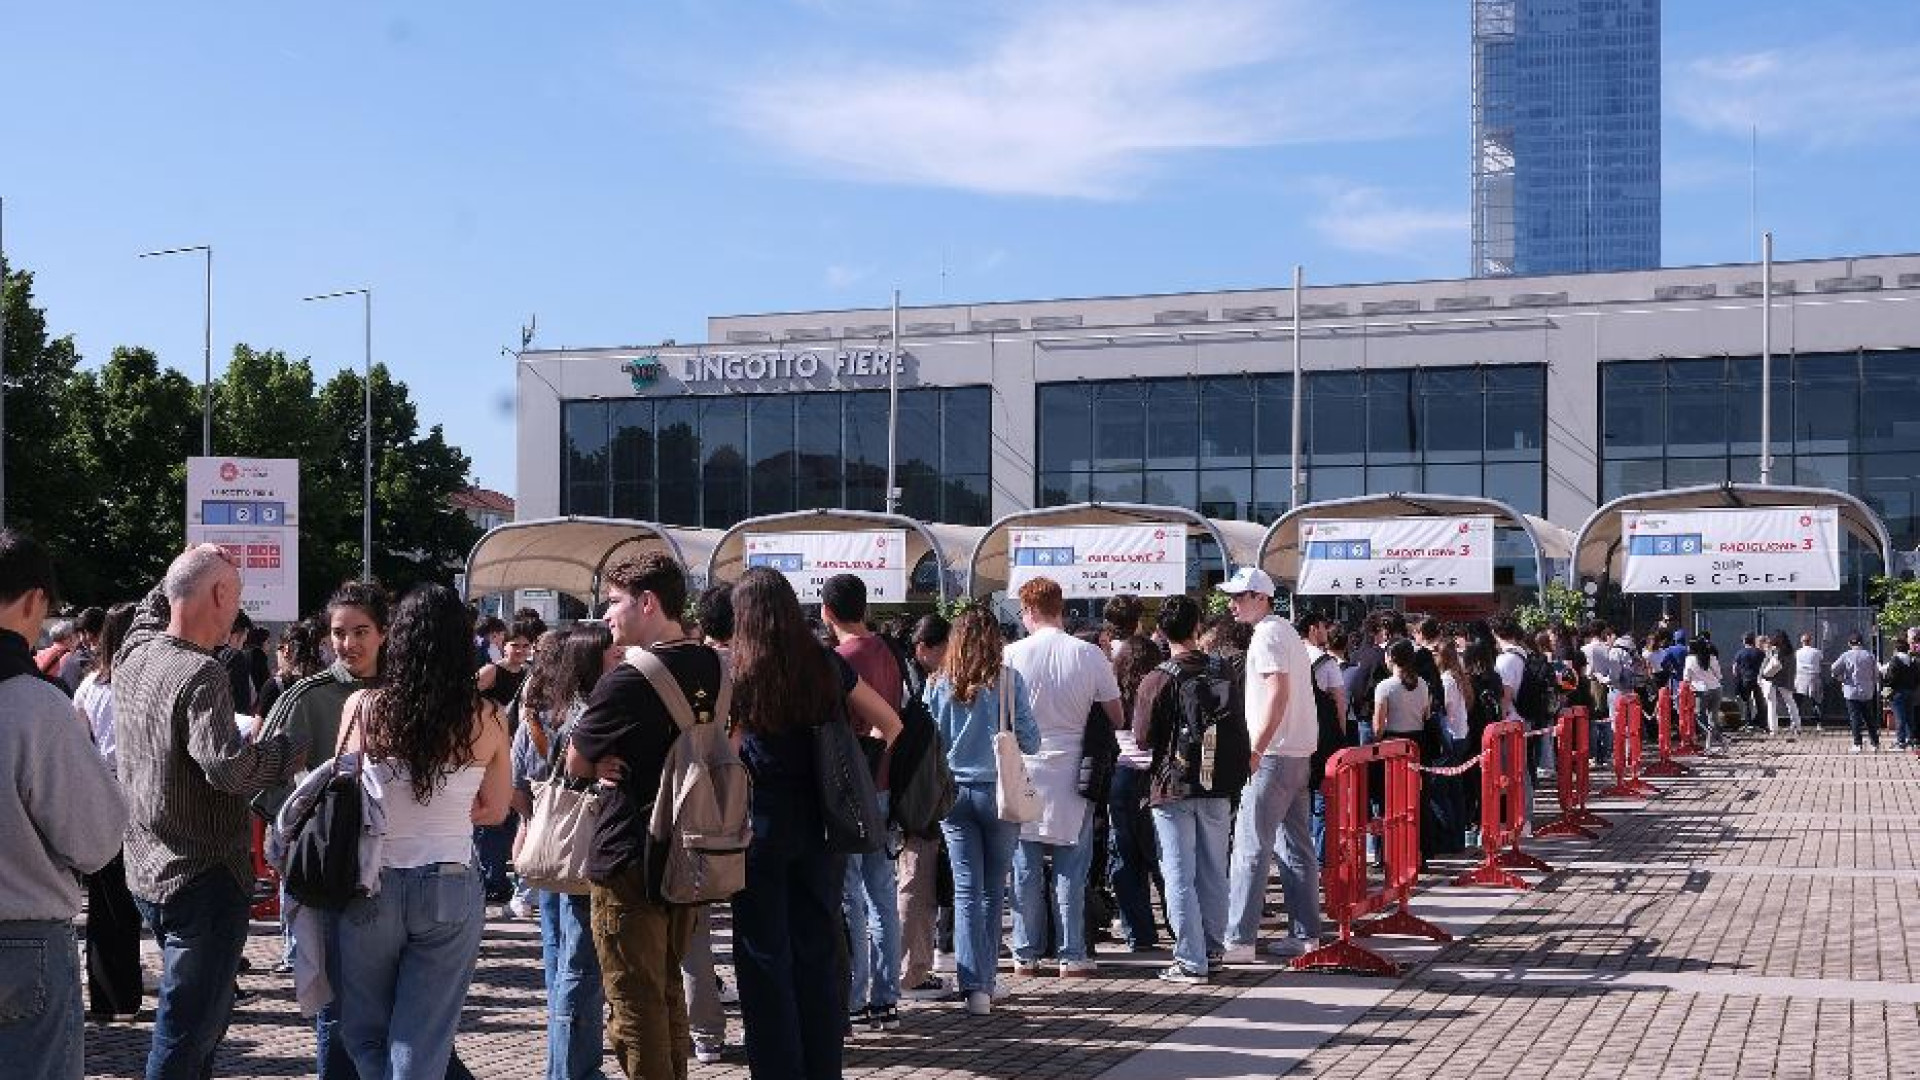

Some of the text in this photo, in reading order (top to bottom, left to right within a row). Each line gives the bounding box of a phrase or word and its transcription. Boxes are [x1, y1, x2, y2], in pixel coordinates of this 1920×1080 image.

[679, 353, 819, 382] LINGOTTO
[836, 350, 905, 376] FIERE
[1802, 538, 1814, 550] 3
[1156, 550, 1165, 562] 2
[1459, 545, 1470, 556] 3
[876, 557, 886, 569] 2
[1712, 560, 1744, 571] aule
